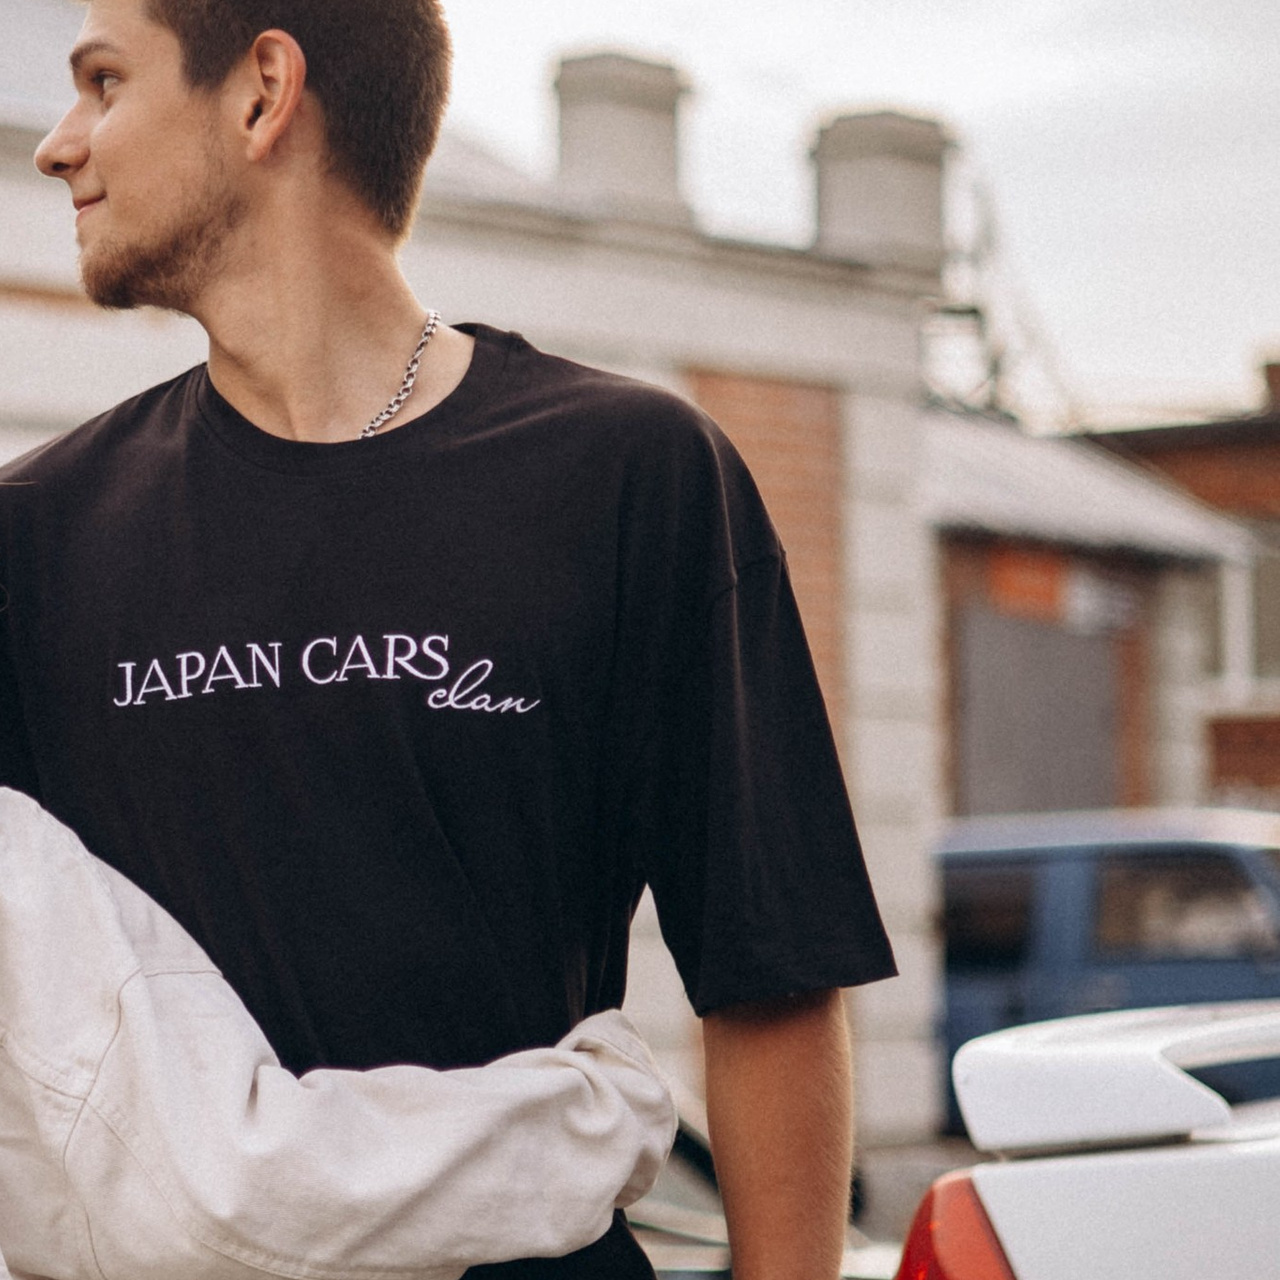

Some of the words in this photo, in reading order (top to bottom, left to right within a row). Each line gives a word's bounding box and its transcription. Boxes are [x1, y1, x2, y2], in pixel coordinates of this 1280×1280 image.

[113, 641, 282, 707] JAPAN
[301, 633, 450, 684] CARS
[427, 658, 541, 714] clan
